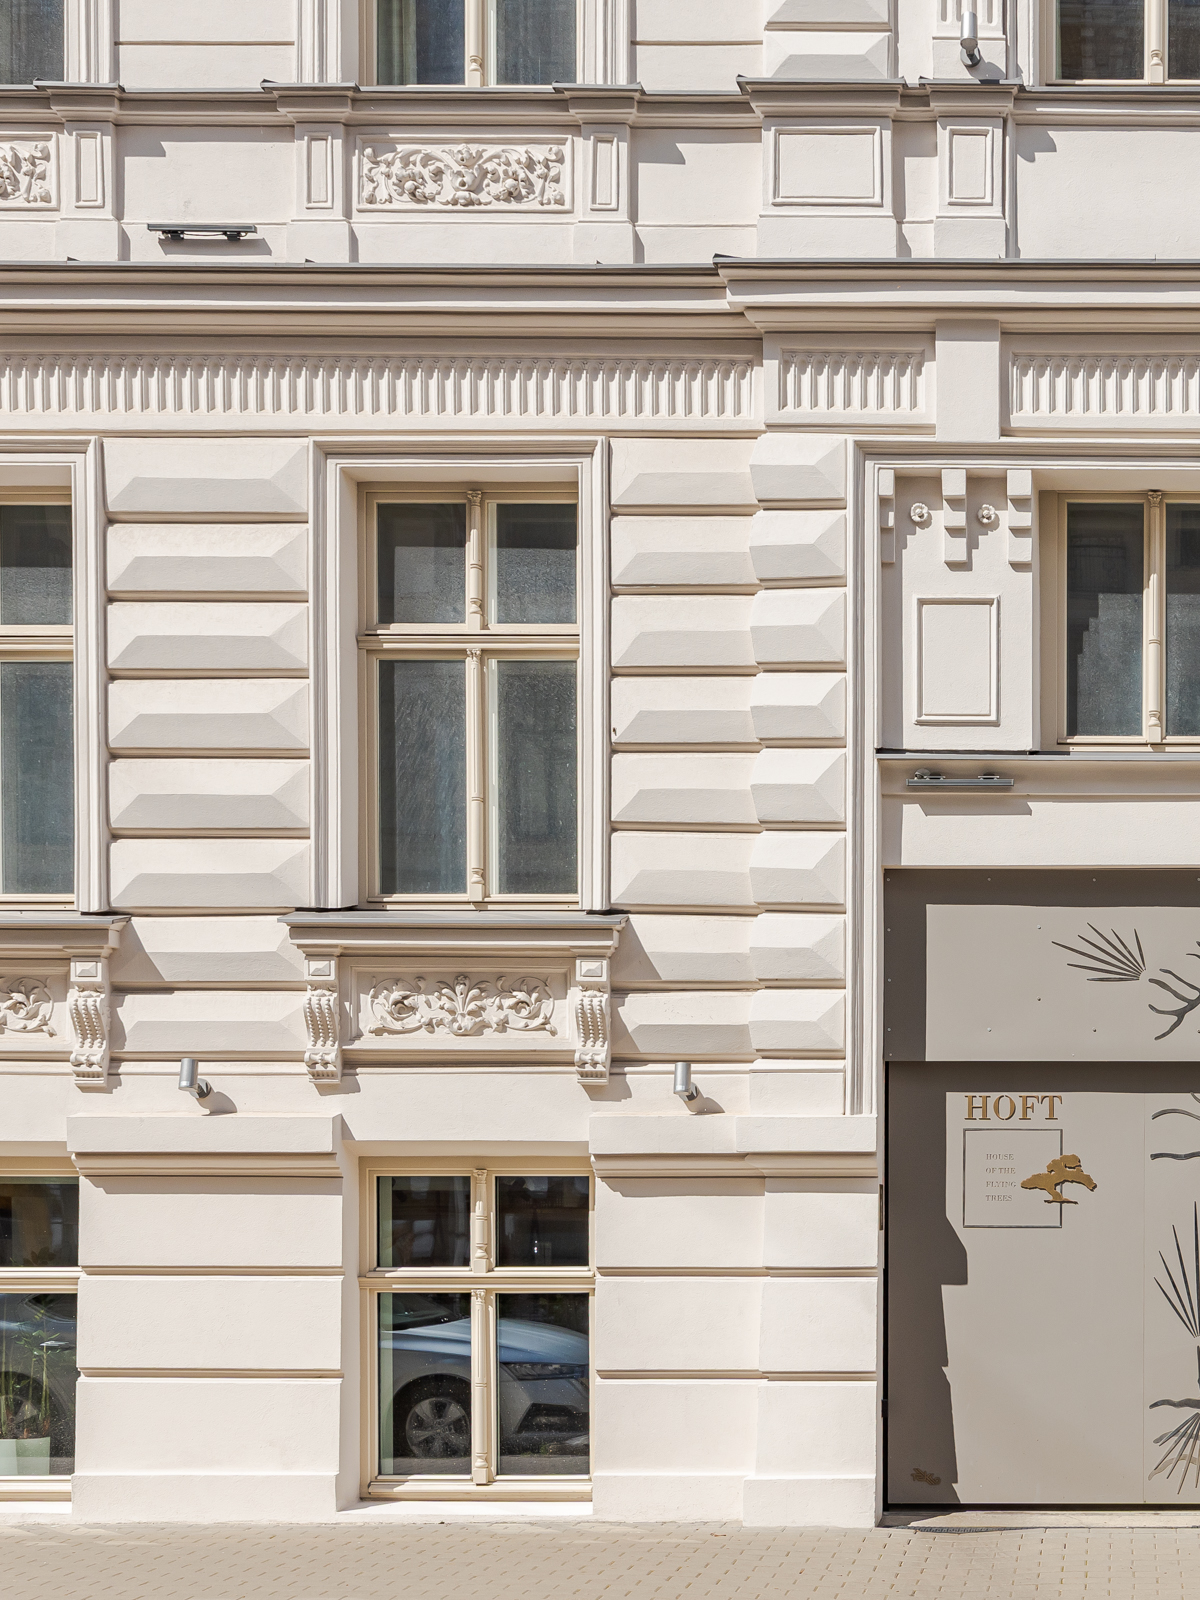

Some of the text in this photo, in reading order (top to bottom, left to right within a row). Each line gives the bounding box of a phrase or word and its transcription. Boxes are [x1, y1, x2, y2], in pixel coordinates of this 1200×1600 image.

[964, 1094, 1062, 1121] HOFT
[986, 1153, 1015, 1161] HOUSE
[985, 1194, 1013, 1202] TREES
